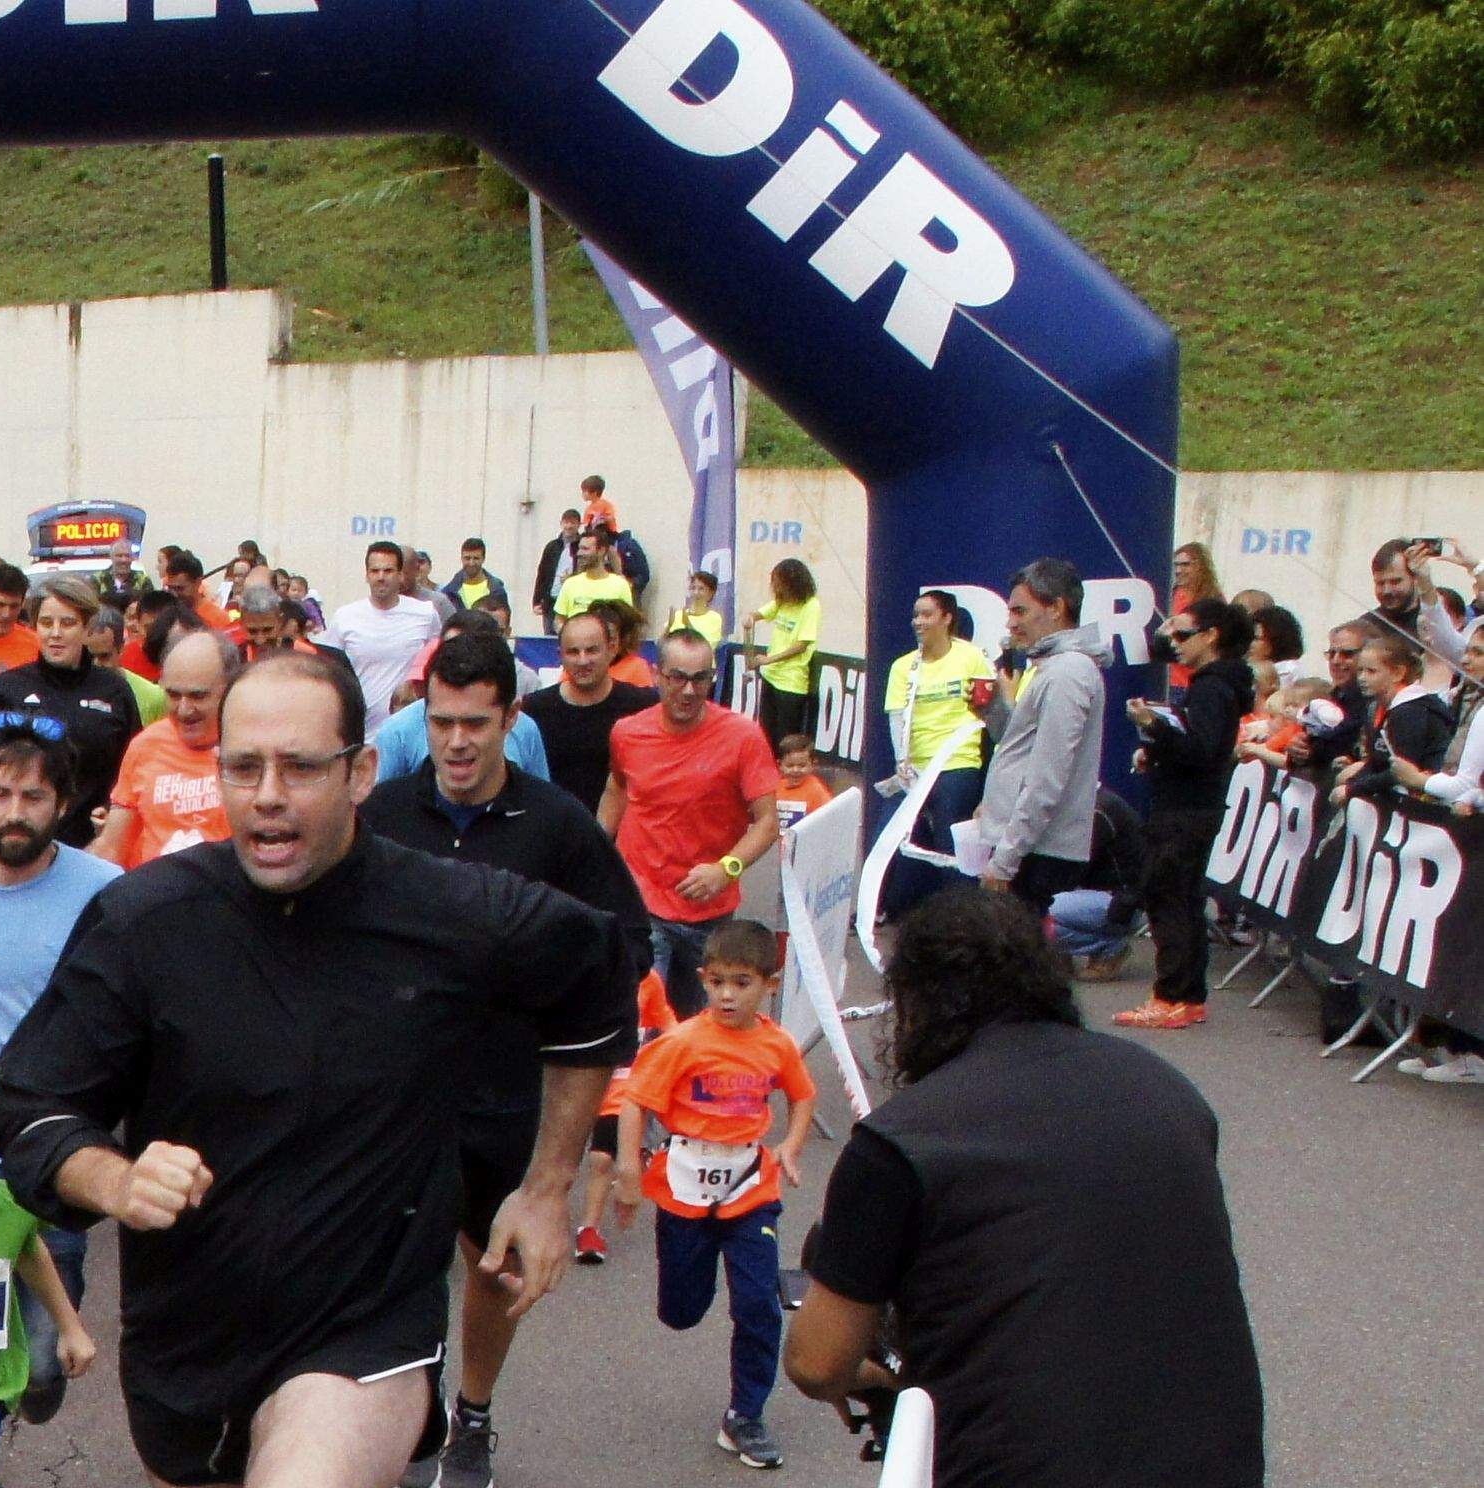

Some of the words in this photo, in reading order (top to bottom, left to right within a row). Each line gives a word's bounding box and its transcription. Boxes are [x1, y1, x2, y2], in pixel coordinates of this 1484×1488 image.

[596, 0, 1015, 370] DiR
[56, 522, 120, 540] POLICIA
[750, 520, 804, 545] DiR
[1241, 527, 1312, 556] DiR
[1205, 758, 1318, 919] DiR
[1315, 796, 1463, 990] DiR
[697, 1168, 733, 1186] 161
